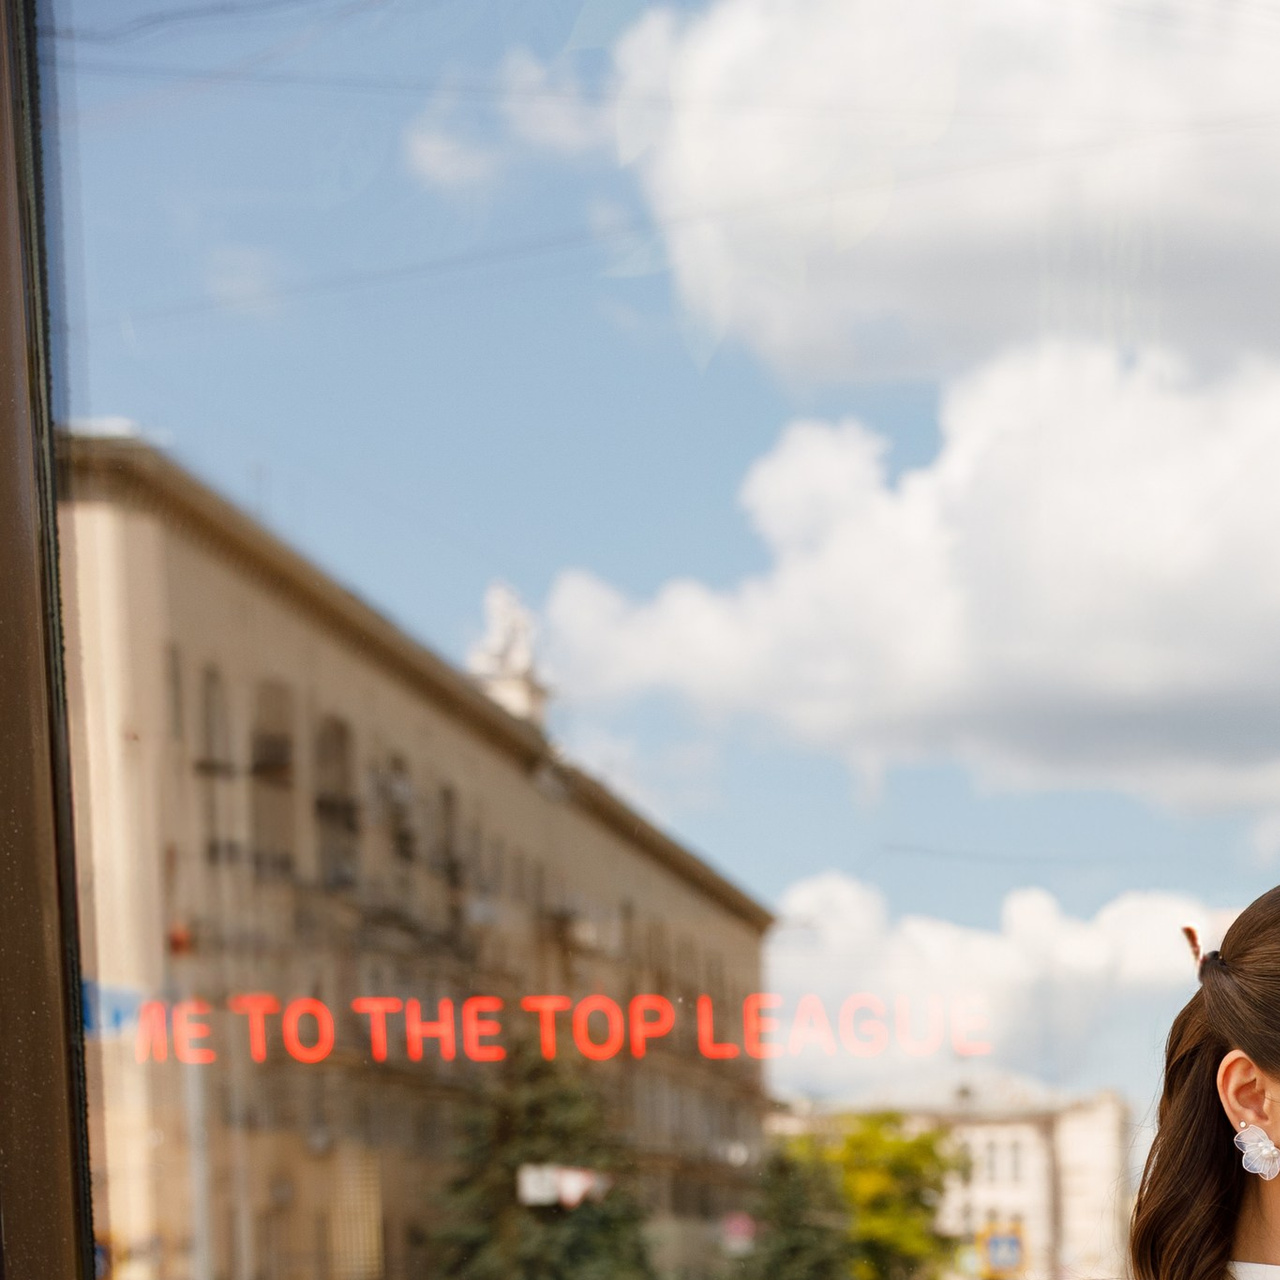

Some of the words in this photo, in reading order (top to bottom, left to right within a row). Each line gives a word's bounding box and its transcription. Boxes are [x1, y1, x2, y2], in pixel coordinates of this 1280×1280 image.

[229, 992, 335, 1064] TO
[351, 996, 507, 1063] THE
[520, 994, 676, 1061] TOP
[697, 992, 994, 1060] LEAGUE
